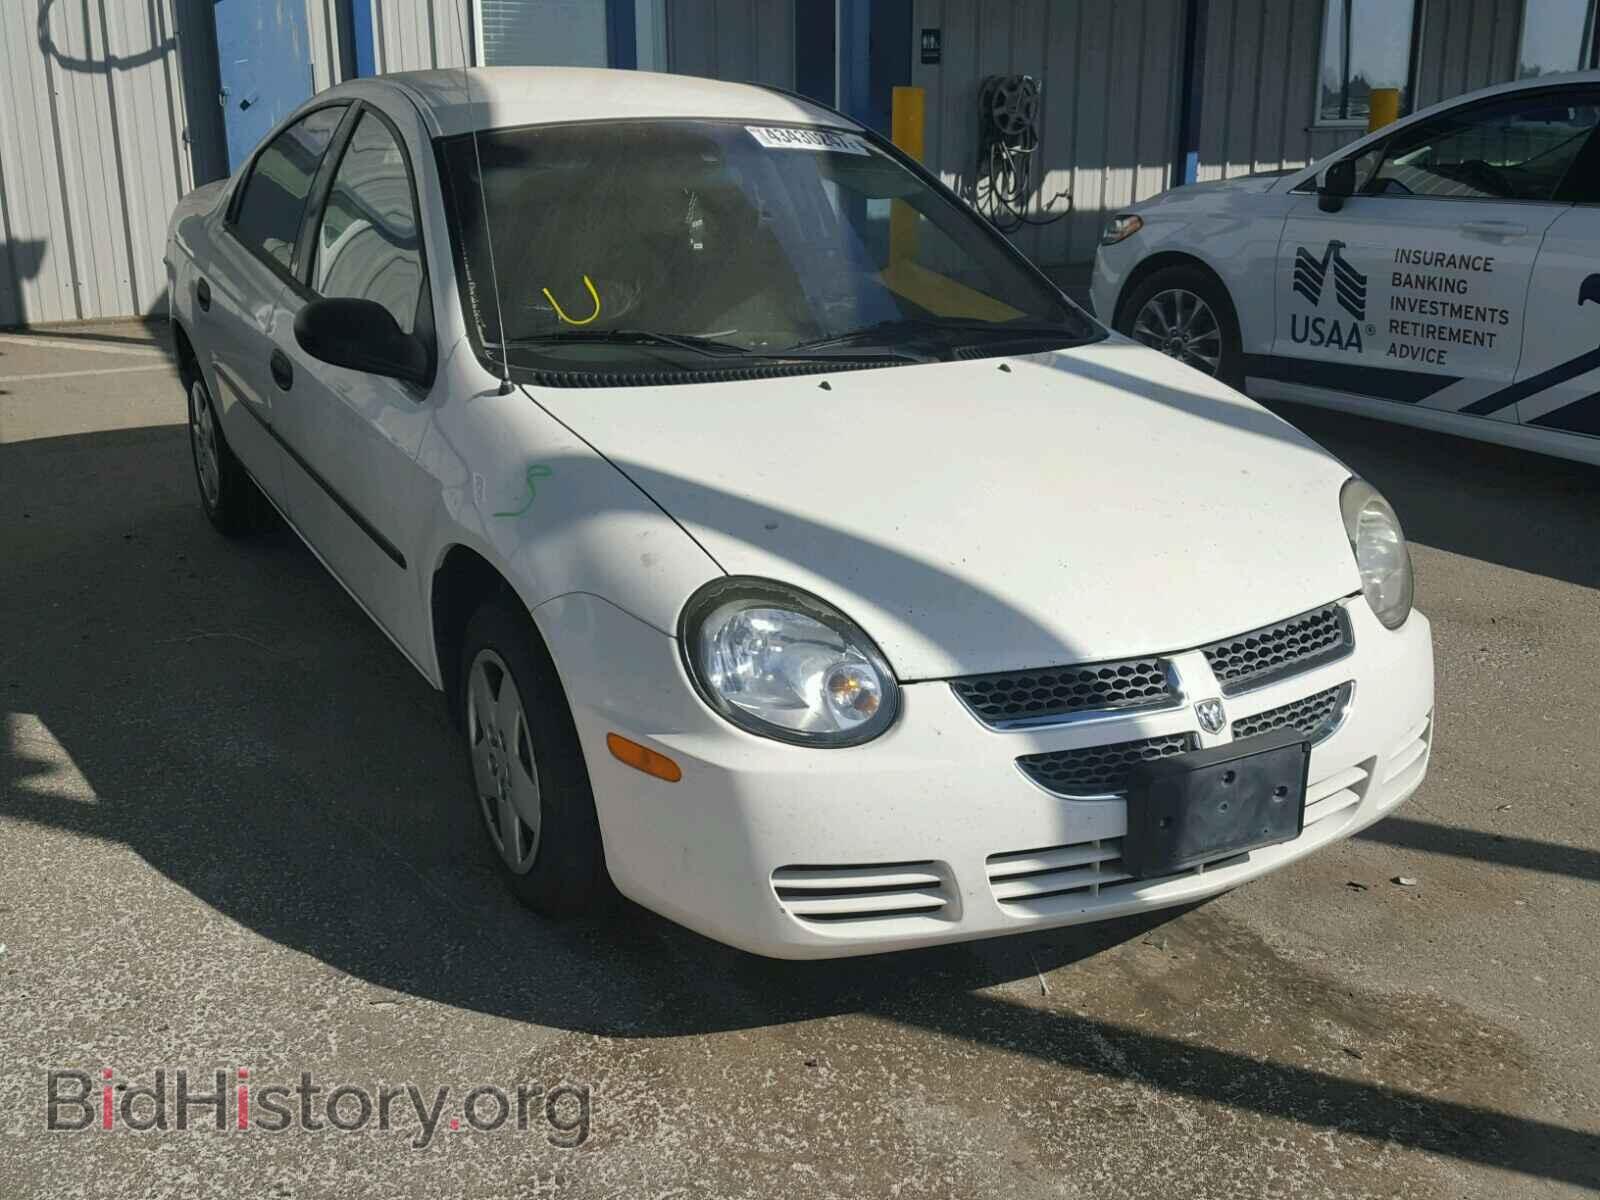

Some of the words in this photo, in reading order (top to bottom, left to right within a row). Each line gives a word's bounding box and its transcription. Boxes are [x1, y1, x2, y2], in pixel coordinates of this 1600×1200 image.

[1394, 247, 1495, 272] INSURANCE
[1391, 272, 1468, 295] BANKING
[1389, 295, 1510, 325] INVESTMENTS
[1388, 319, 1497, 349] RETIREMENT
[1386, 342, 1447, 365] ADVICE
